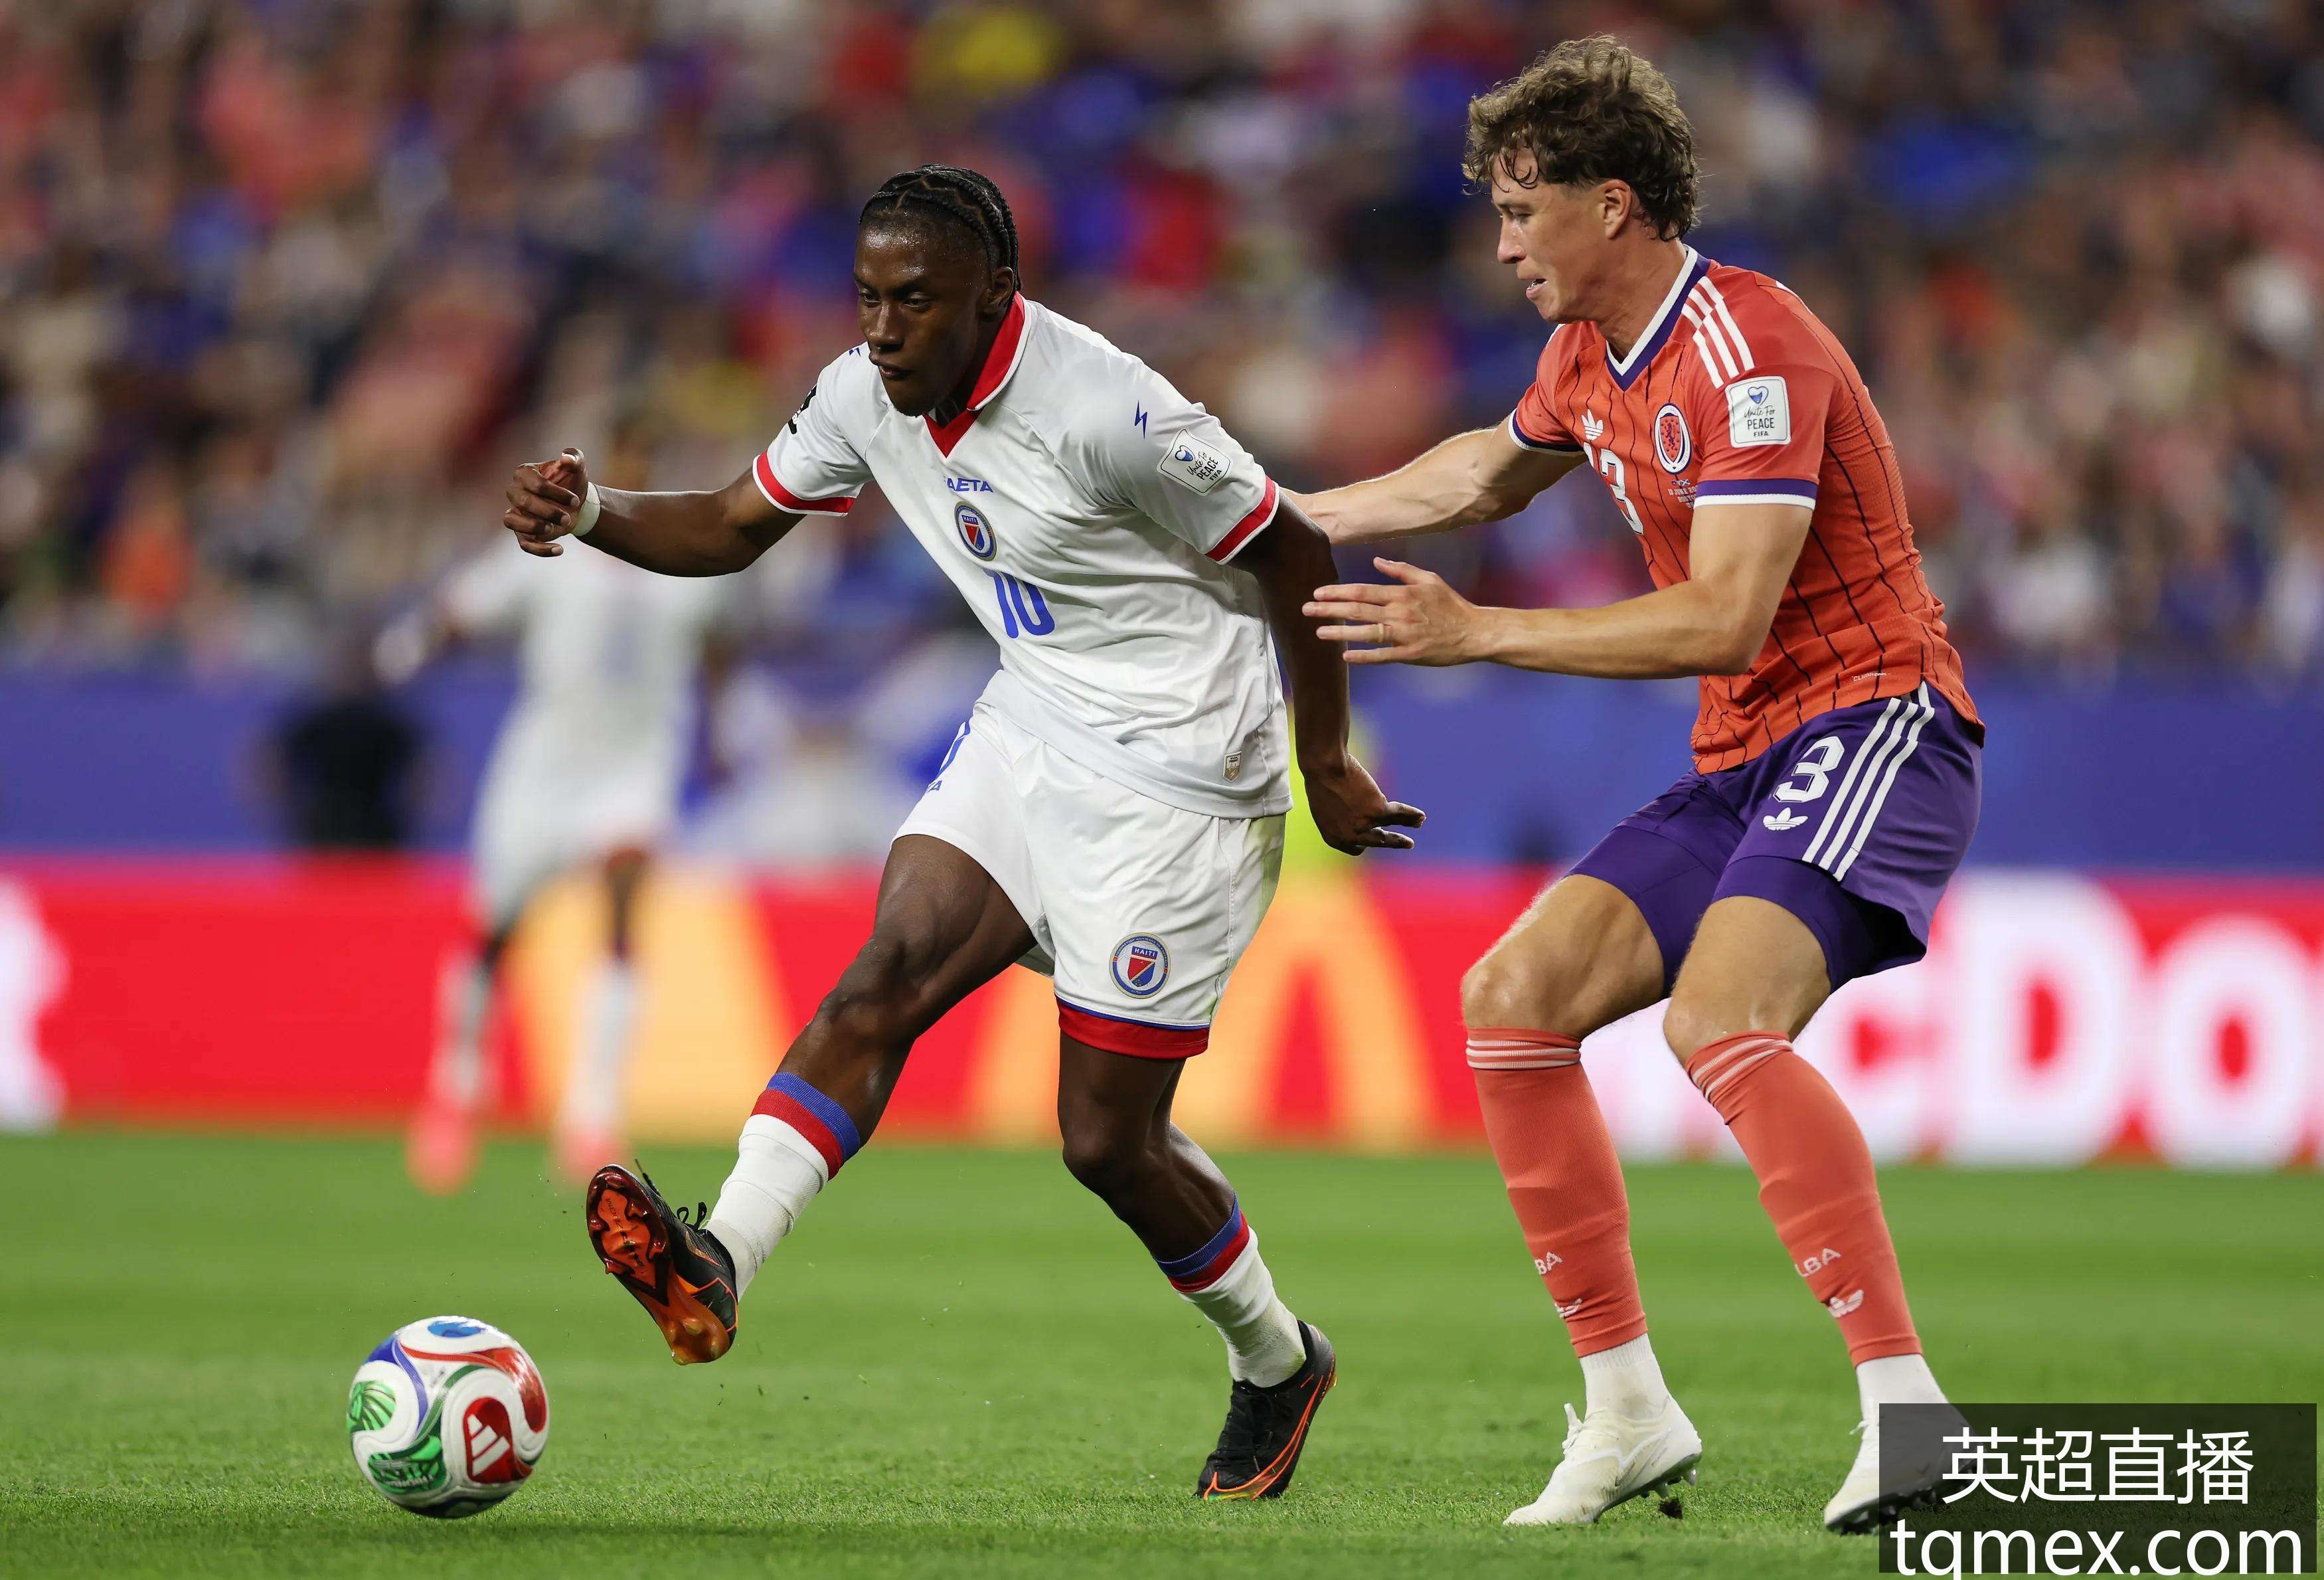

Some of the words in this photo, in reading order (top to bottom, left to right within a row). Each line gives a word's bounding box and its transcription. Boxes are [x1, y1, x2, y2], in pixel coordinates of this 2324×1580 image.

[1744, 406, 1764, 418] Unite
[1764, 404, 1776, 416] For
[1747, 418, 1775, 430] PEACE
[1196, 457, 1218, 480] PEACE
[1209, 469, 1222, 481] FIFA
[943, 476, 994, 493] AETA
[983, 569, 1055, 639] 10
[1768, 736, 1845, 803] 3
[1134, 948, 1155, 957] HAITI
[1795, 1248, 1841, 1277] LBA
